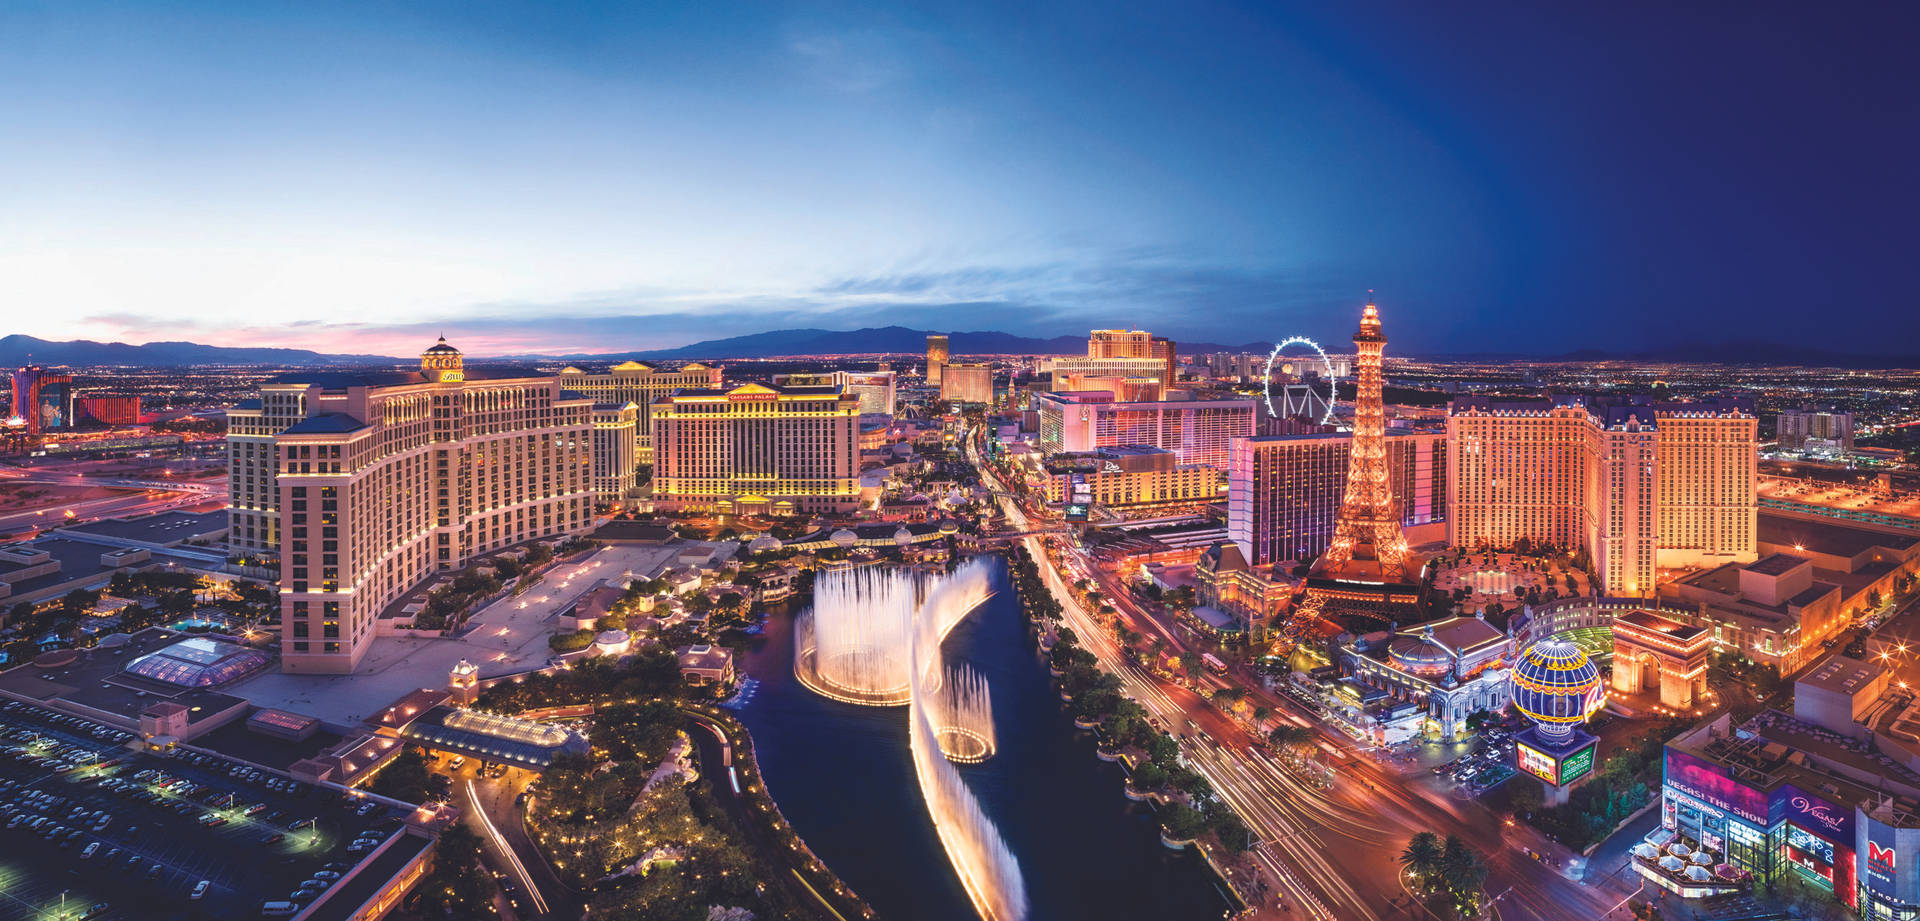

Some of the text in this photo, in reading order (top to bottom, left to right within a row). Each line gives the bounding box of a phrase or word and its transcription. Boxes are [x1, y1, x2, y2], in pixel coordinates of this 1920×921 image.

[1666, 778, 1768, 826] VEGAS! THE SHOW
[1803, 858, 1815, 869] M
[1868, 840, 1896, 869] M
